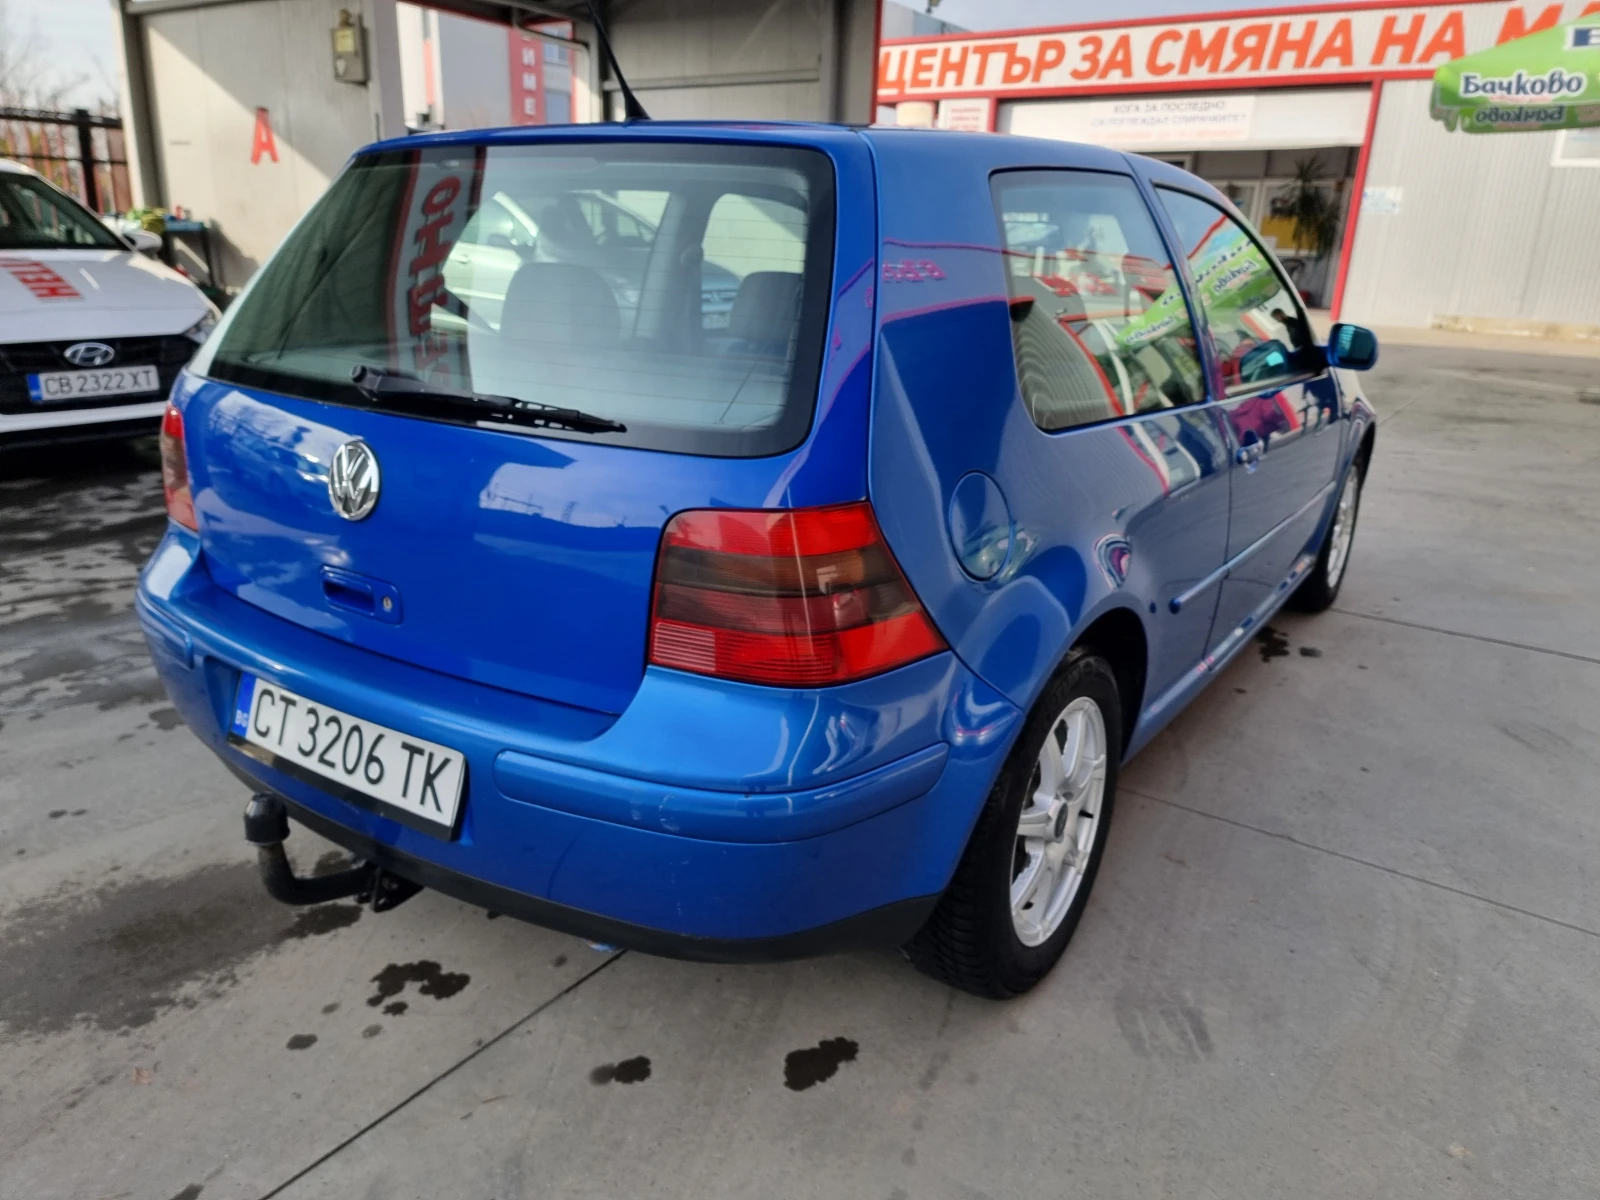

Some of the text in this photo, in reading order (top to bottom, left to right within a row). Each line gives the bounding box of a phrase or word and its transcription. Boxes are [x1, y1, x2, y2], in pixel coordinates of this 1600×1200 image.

[877, 40, 1067, 95] ЦЕНТЪР
[1069, 34, 1133, 81] ЗА
[1145, 18, 1354, 77] СМЯНА
[1370, 11, 1466, 65] НА
[1462, 70, 1585, 96] Бачково
[44, 370, 153, 396] CB 2322 XT
[253, 689, 452, 814] CT 3206 TK
